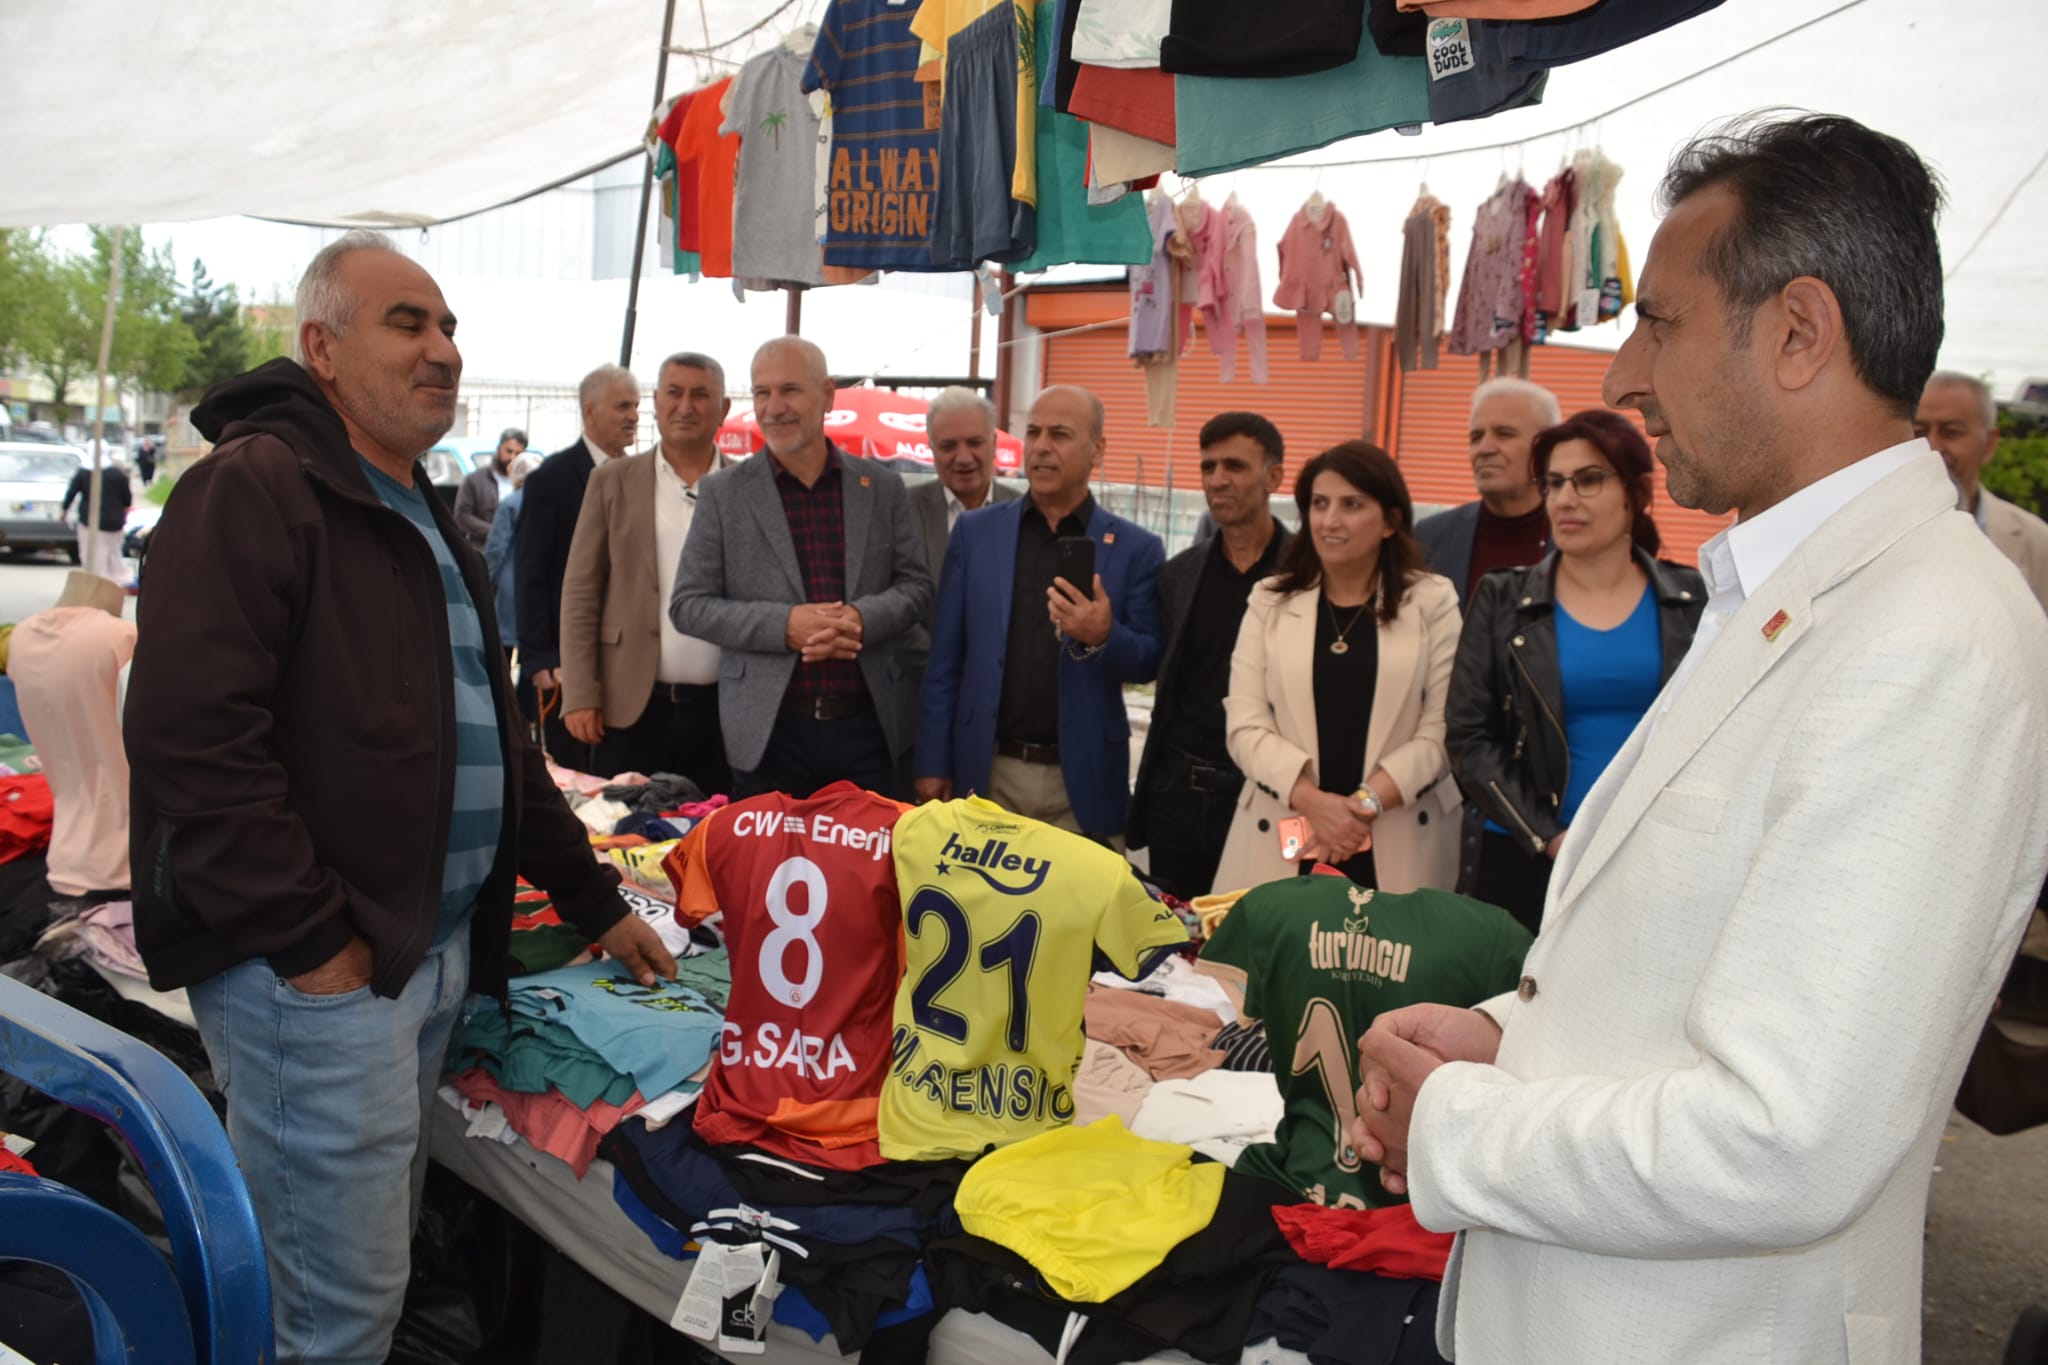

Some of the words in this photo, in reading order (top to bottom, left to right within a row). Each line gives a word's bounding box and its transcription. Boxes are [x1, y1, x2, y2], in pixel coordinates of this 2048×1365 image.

[1433, 41, 1466, 60] COOL
[1435, 53, 1469, 74] DUDE
[830, 190, 929, 236] ORIGIN
[733, 810, 784, 837] CW
[812, 814, 891, 861] Enerji
[940, 832, 1052, 896] halley
[758, 855, 829, 1009] 8
[1309, 920, 1412, 983] turuncu
[906, 884, 1041, 1053] 21
[720, 1021, 856, 1081] G.SARA
